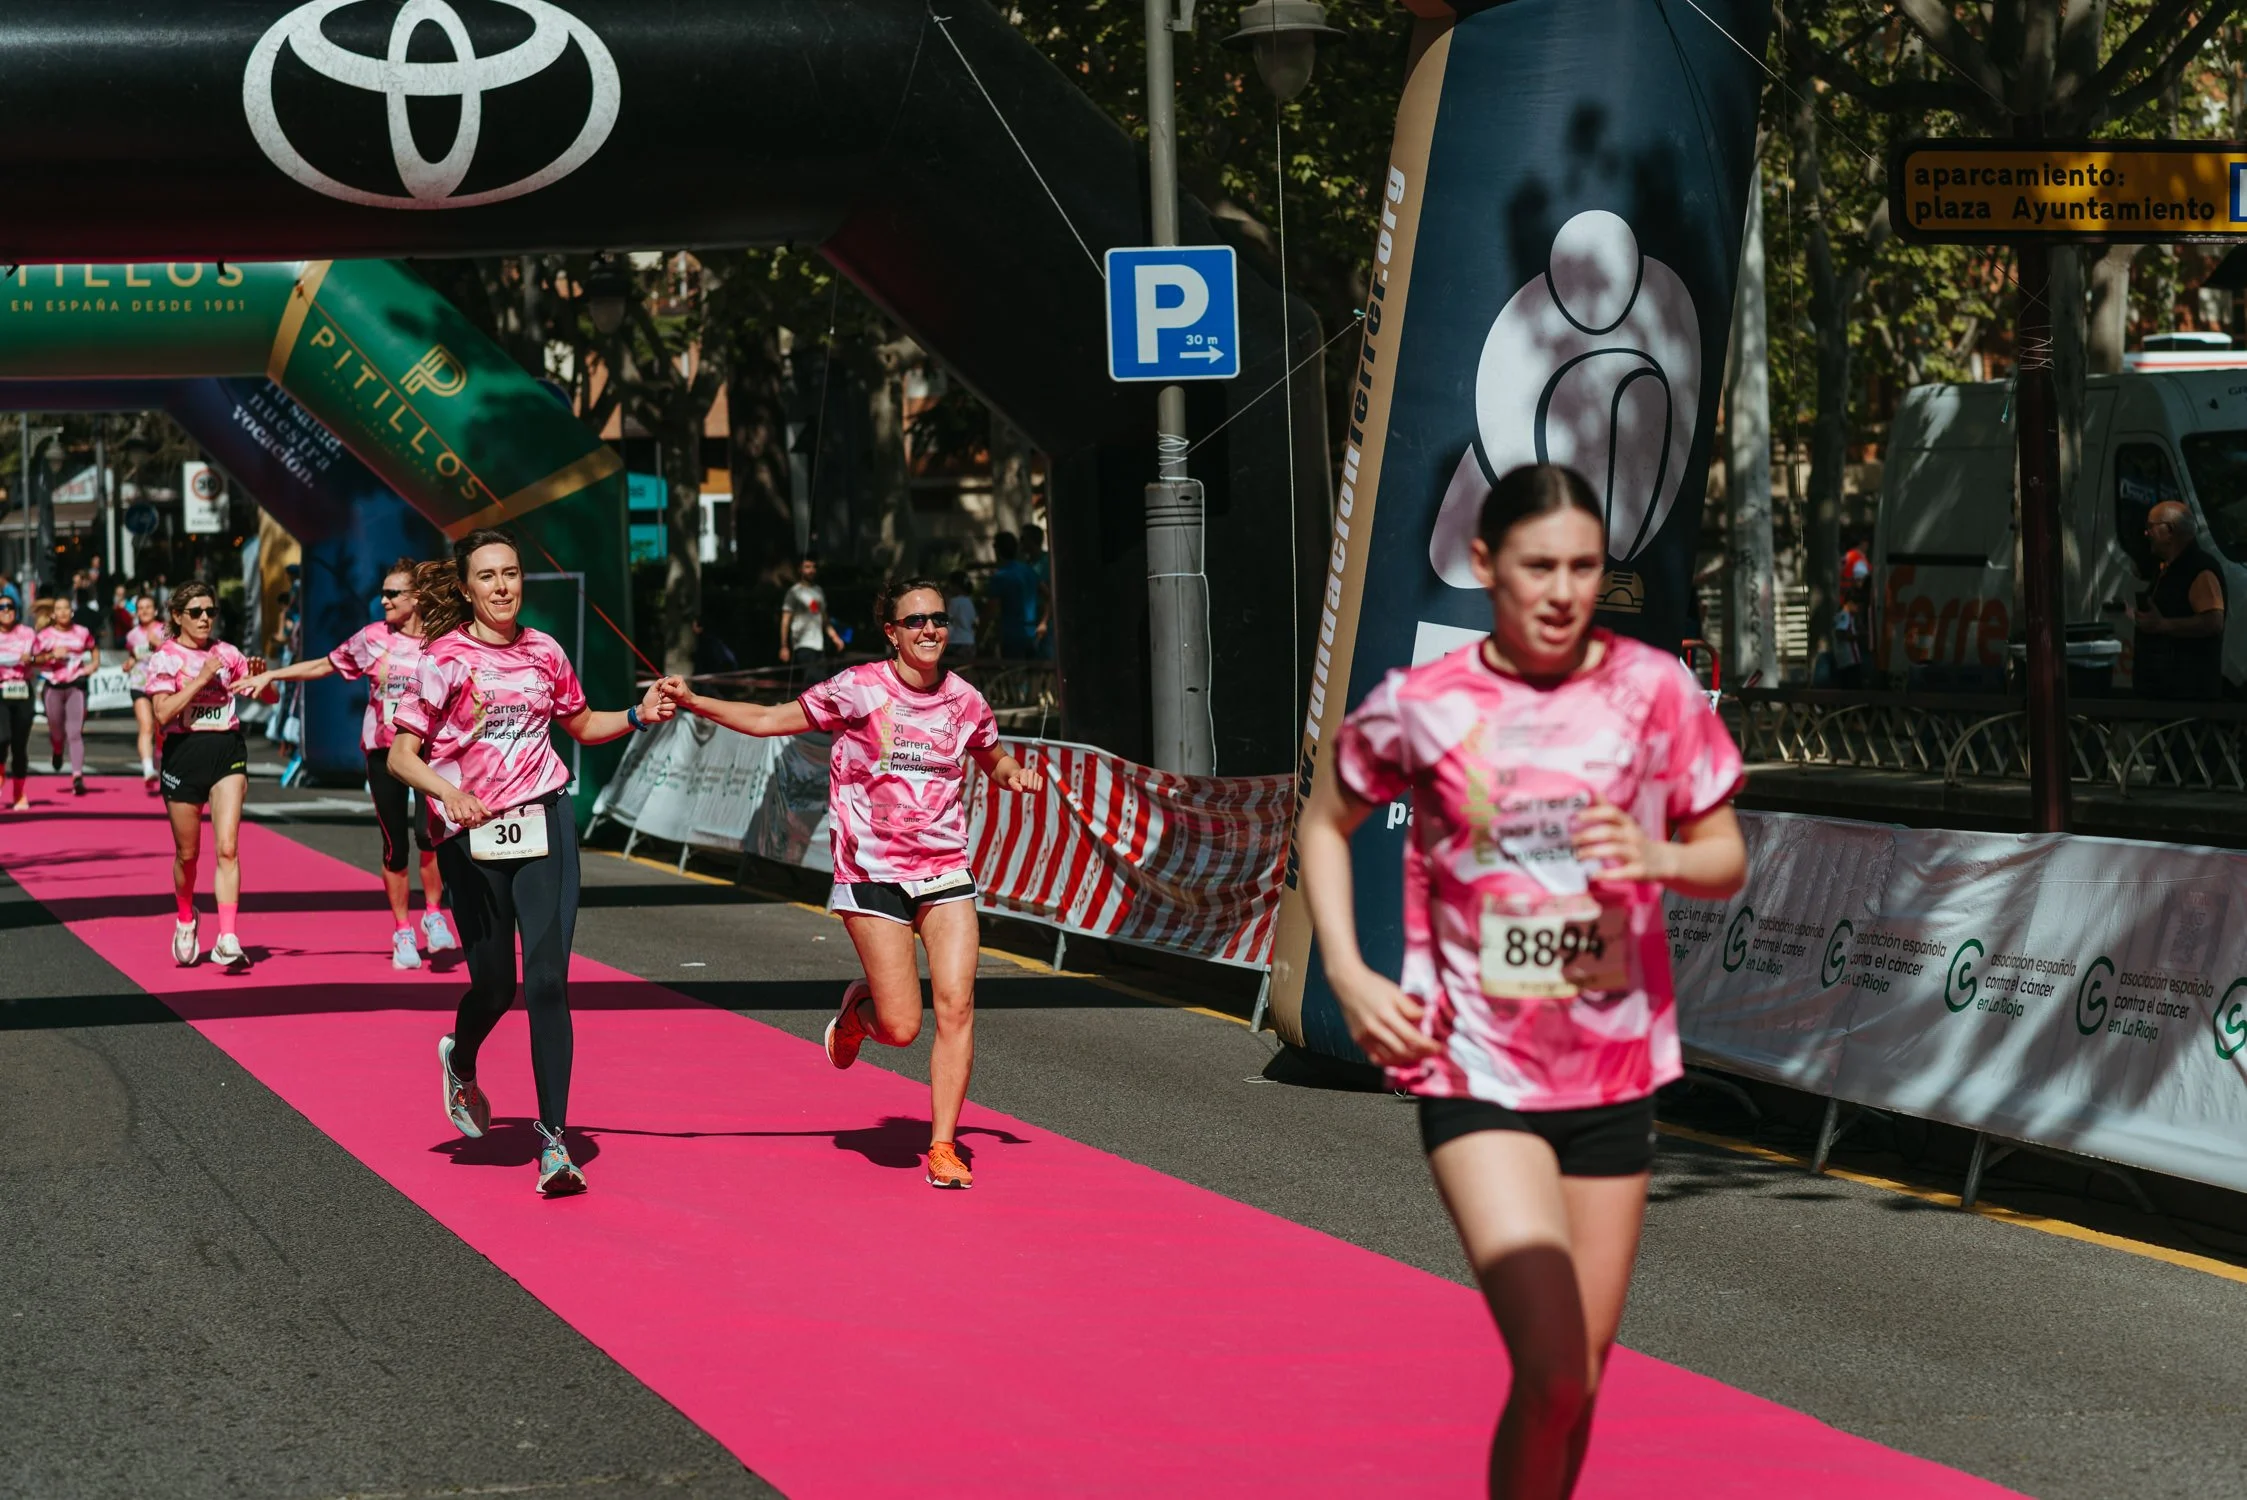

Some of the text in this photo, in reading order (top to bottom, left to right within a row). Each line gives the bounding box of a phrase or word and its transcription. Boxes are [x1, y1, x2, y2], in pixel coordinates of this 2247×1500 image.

[1914, 163, 2125, 190] aparcamiento:
[1914, 196, 2216, 224] plaza Ayuntamiento
[11, 300, 33, 312] EN
[46, 298, 119, 312] ESPAÑA
[132, 299, 193, 312] DESDE
[1134, 264, 1209, 364] P
[1186, 334, 1218, 345] 30 m
[483, 690, 496, 701] XI
[191, 706, 221, 719] 7860
[485, 704, 527, 715] Carrera
[485, 716, 515, 730] por la
[893, 723, 904, 734] XI
[893, 737, 931, 750] Carrera
[892, 751, 921, 762] por la
[494, 823, 522, 844] 30
[1505, 922, 1605, 968] 8894
[1902, 939, 1947, 957] española
[1874, 954, 1887, 968] el
[1888, 954, 1924, 976] cáncer
[2035, 959, 2077, 977] española
[1861, 973, 1891, 995] Rioja
[1985, 974, 2055, 997] contra el cáncer
[2120, 971, 2214, 998] asociación española
[1977, 996, 2024, 1020] en La Rioja
[2114, 995, 2190, 1019] contra el cáncer
[2108, 1018, 2158, 1043] en La Rioja
